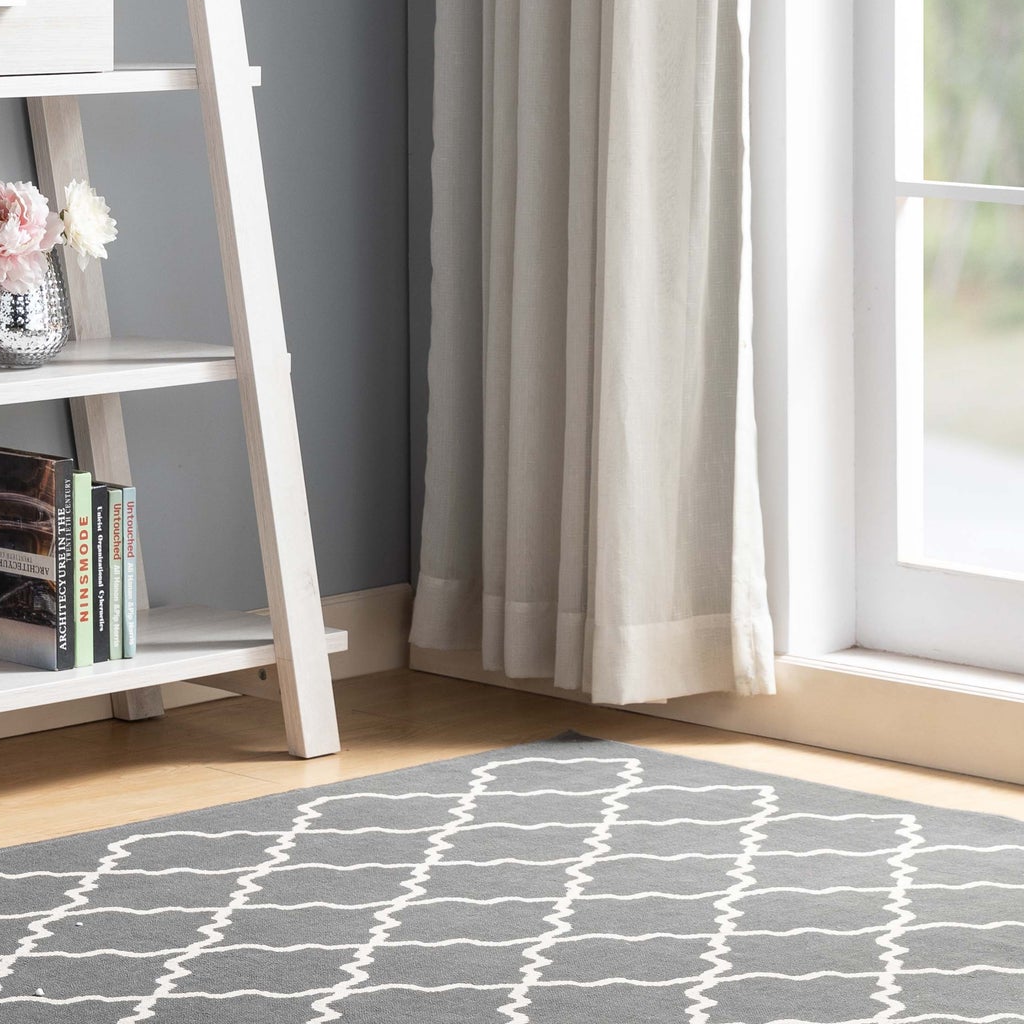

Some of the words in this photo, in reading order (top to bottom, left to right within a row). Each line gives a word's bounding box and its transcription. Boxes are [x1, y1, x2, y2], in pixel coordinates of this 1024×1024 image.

[57, 507, 66, 535] THE
[58, 536, 66, 551] IN
[113, 503, 122, 561] Untouched
[126, 501, 135, 559] Untouched
[79, 516, 89, 623] NINSMODE
[58, 552, 67, 650] ARCHITECYURE
